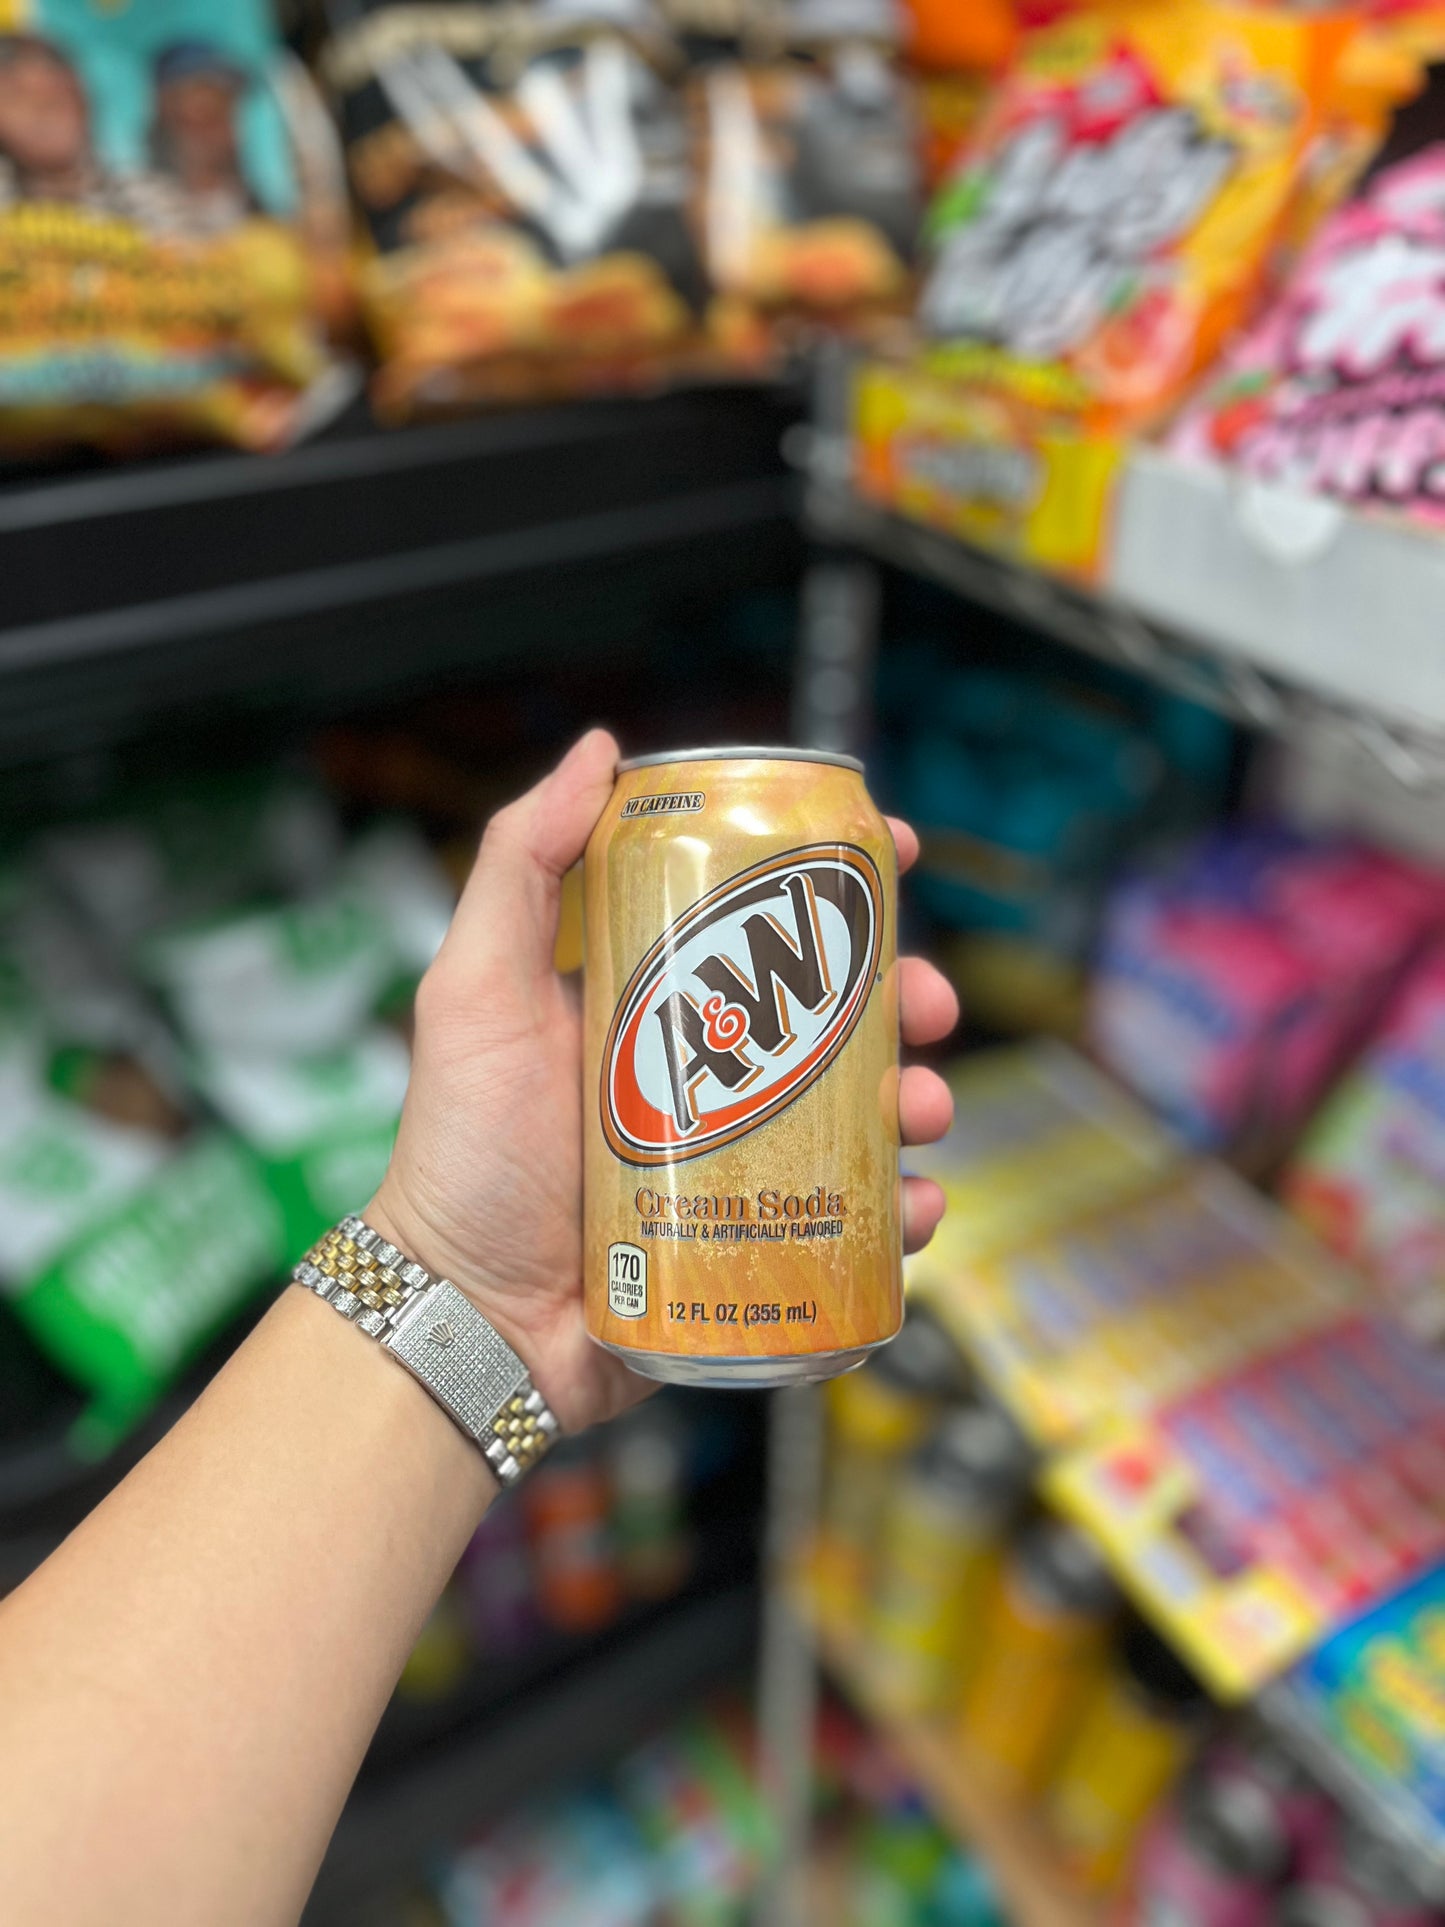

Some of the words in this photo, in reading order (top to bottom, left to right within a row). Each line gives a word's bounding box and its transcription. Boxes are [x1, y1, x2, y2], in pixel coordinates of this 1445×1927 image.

[640, 793, 702, 812] CAFFEINE
[654, 872, 838, 1138] A&W
[635, 1186, 749, 1221] Cream
[758, 1186, 847, 1220] Soda
[641, 1220, 698, 1239] NATURALLY
[701, 1222, 710, 1238] &
[713, 1222, 787, 1239] ARTIFICIALLY
[791, 1220, 843, 1235] FLAVORED
[613, 1253, 640, 1281] 170
[611, 1281, 644, 1298] CALORIES
[614, 1296, 625, 1306] PER
[627, 1297, 639, 1309] CAN
[667, 1302, 686, 1320] 12
[691, 1303, 710, 1321] FL
[716, 1304, 738, 1322] OZ
[744, 1303, 781, 1327] (355
[786, 1301, 817, 1323] mL)
